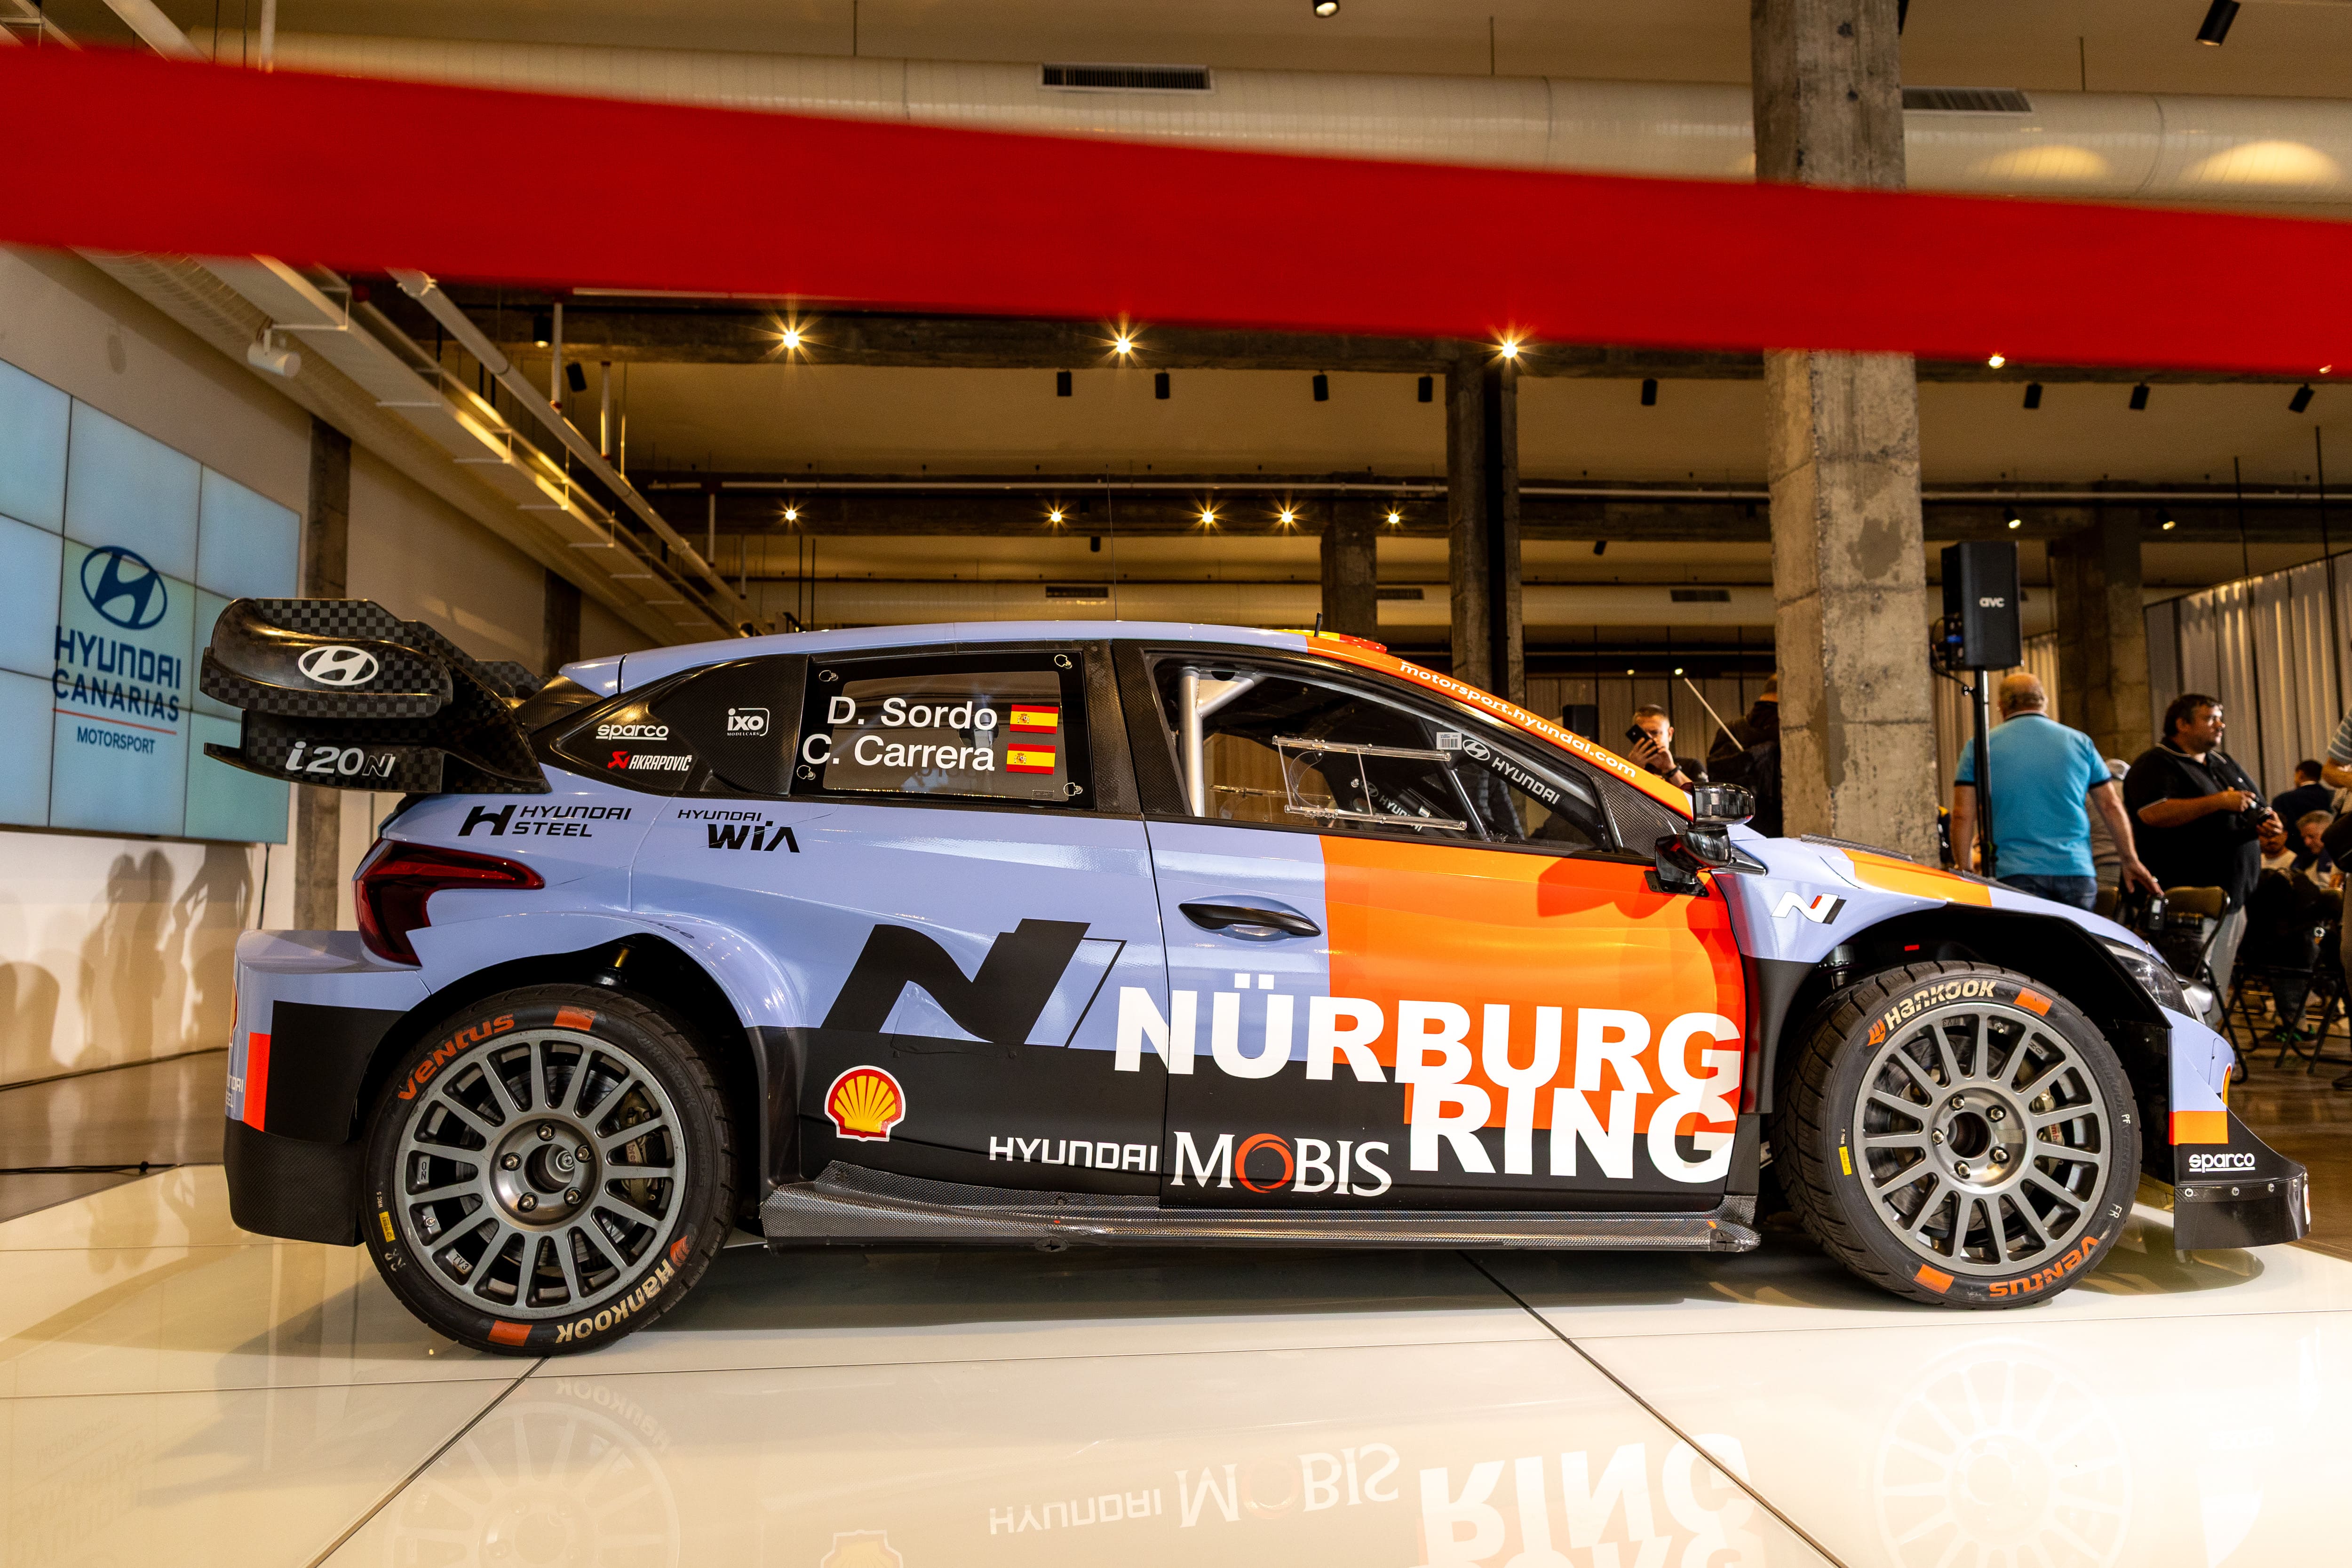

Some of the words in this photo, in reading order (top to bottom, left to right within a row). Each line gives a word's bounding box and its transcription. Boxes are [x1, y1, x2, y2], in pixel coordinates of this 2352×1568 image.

[55, 625, 181, 689] HYUNDAI
[52, 669, 179, 722] CANARIAS
[827, 696, 864, 724] D.
[881, 698, 997, 730] Sordo
[596, 724, 669, 741] sparco
[1400, 662, 1636, 778] motorsport.hyundai.com
[77, 726, 155, 755] MOTORSPORT
[803, 734, 839, 764] C.
[854, 735, 995, 771] Carrera
[1491, 756, 1560, 804] HYUNDAI
[512, 822, 592, 837] STEEL
[519, 806, 632, 820] HYUNDAI
[678, 810, 762, 821] HYUNDAI
[1114, 974, 1741, 1097] NÜRBURG
[1410, 1082, 1739, 1184] RING
[989, 1136, 1157, 1171] HYUNDAI
[1170, 1131, 1392, 1197] MOBIS
[2189, 1153, 2255, 1173] sparco
[453, 1254, 469, 1270] TV3
